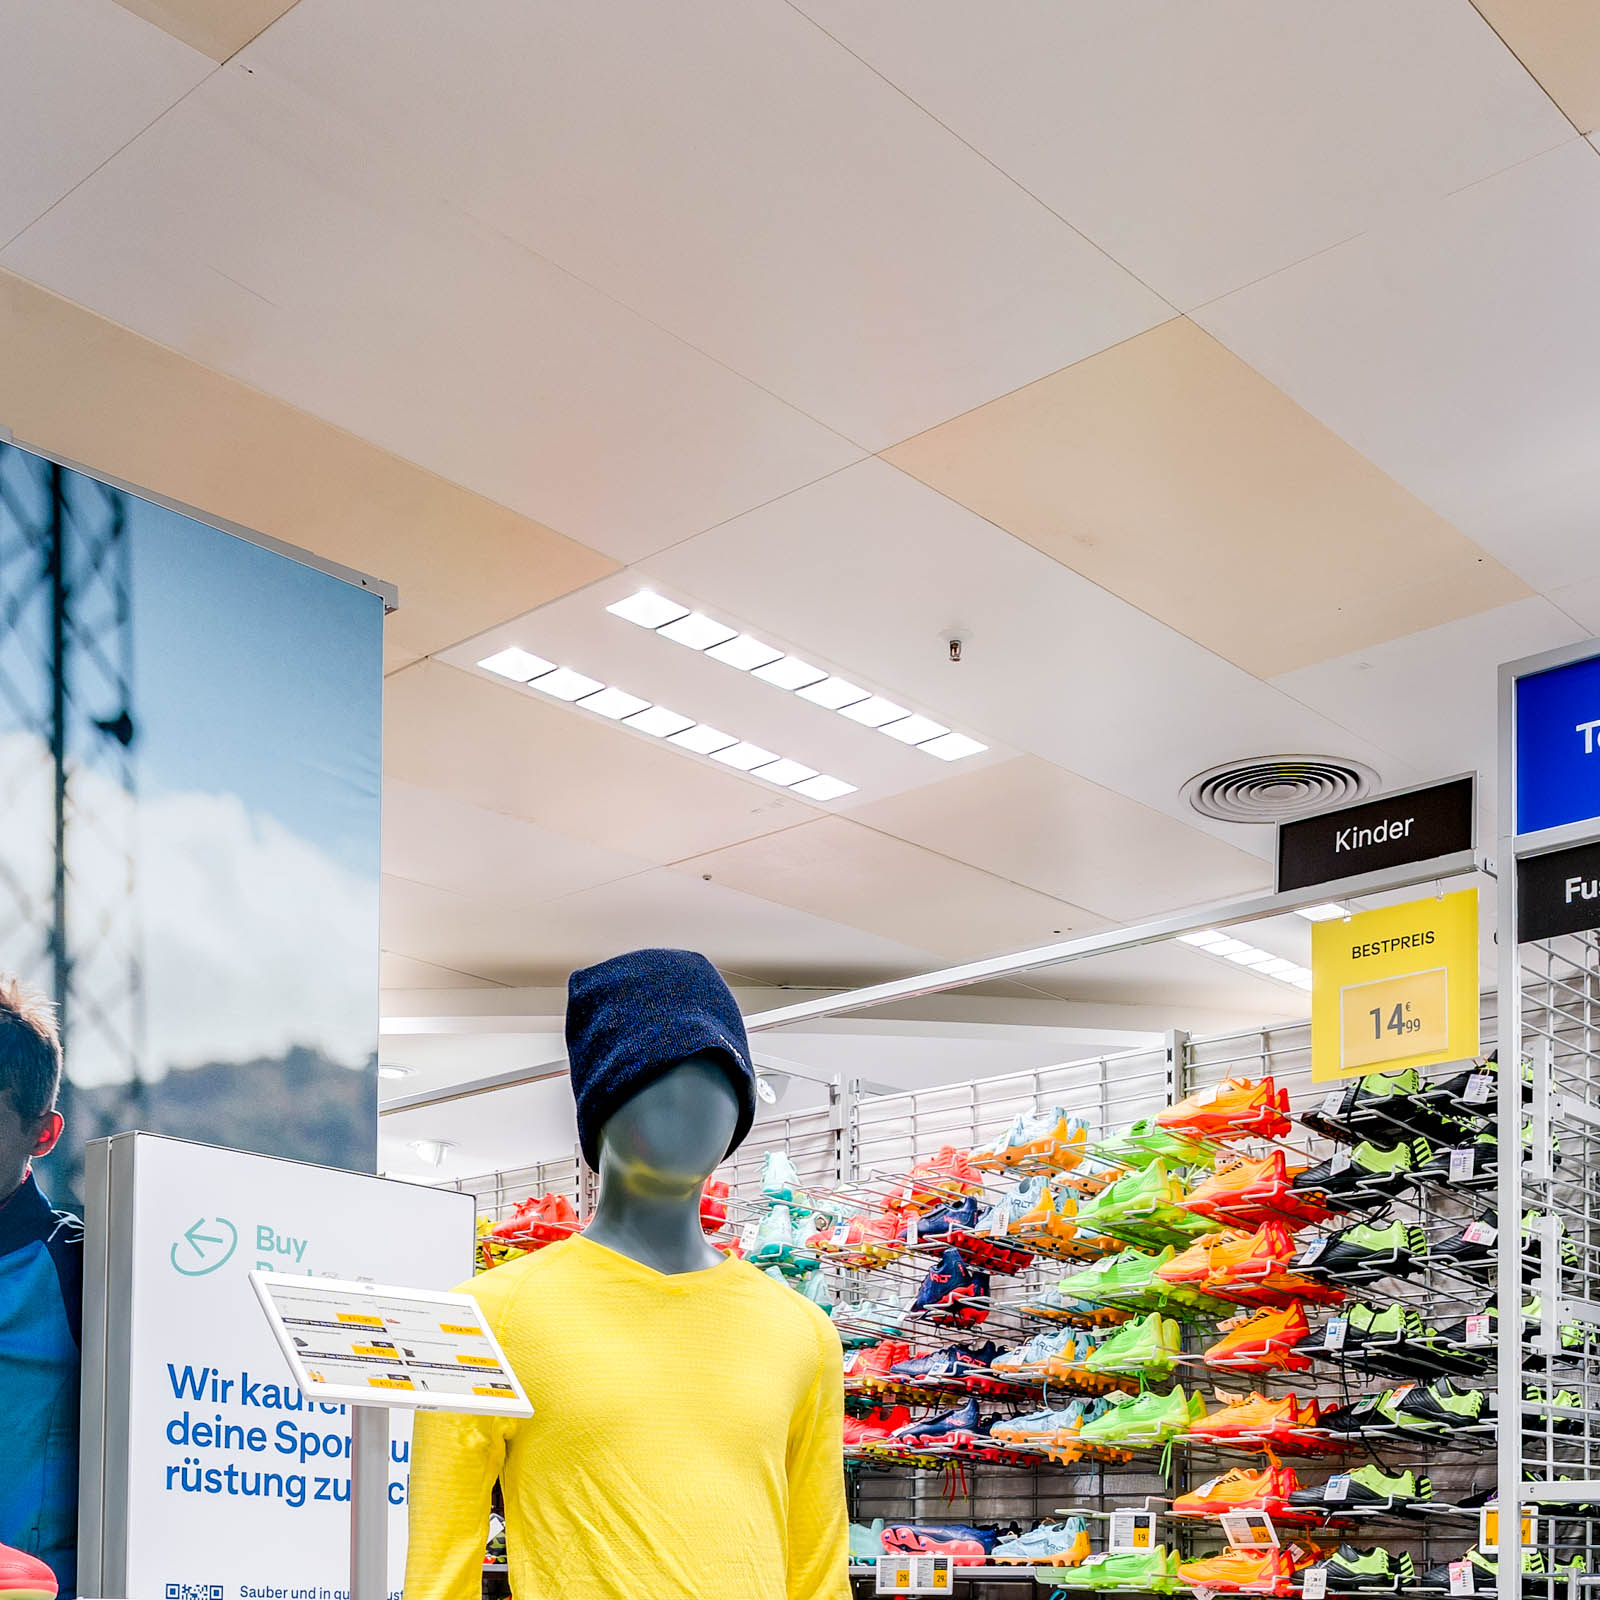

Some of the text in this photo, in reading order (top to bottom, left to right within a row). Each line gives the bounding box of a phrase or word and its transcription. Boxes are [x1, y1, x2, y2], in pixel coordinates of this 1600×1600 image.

[1335, 815, 1414, 853] Kinder
[1351, 930, 1435, 960] BESTPREIS
[256, 1224, 308, 1263] Buy
[166, 1363, 235, 1404] Wir
[166, 1411, 267, 1452] deine
[166, 1457, 306, 1508] rüstung
[239, 1585, 288, 1599] Sauber
[291, 1587, 316, 1600] und
[319, 1587, 331, 1600] in
